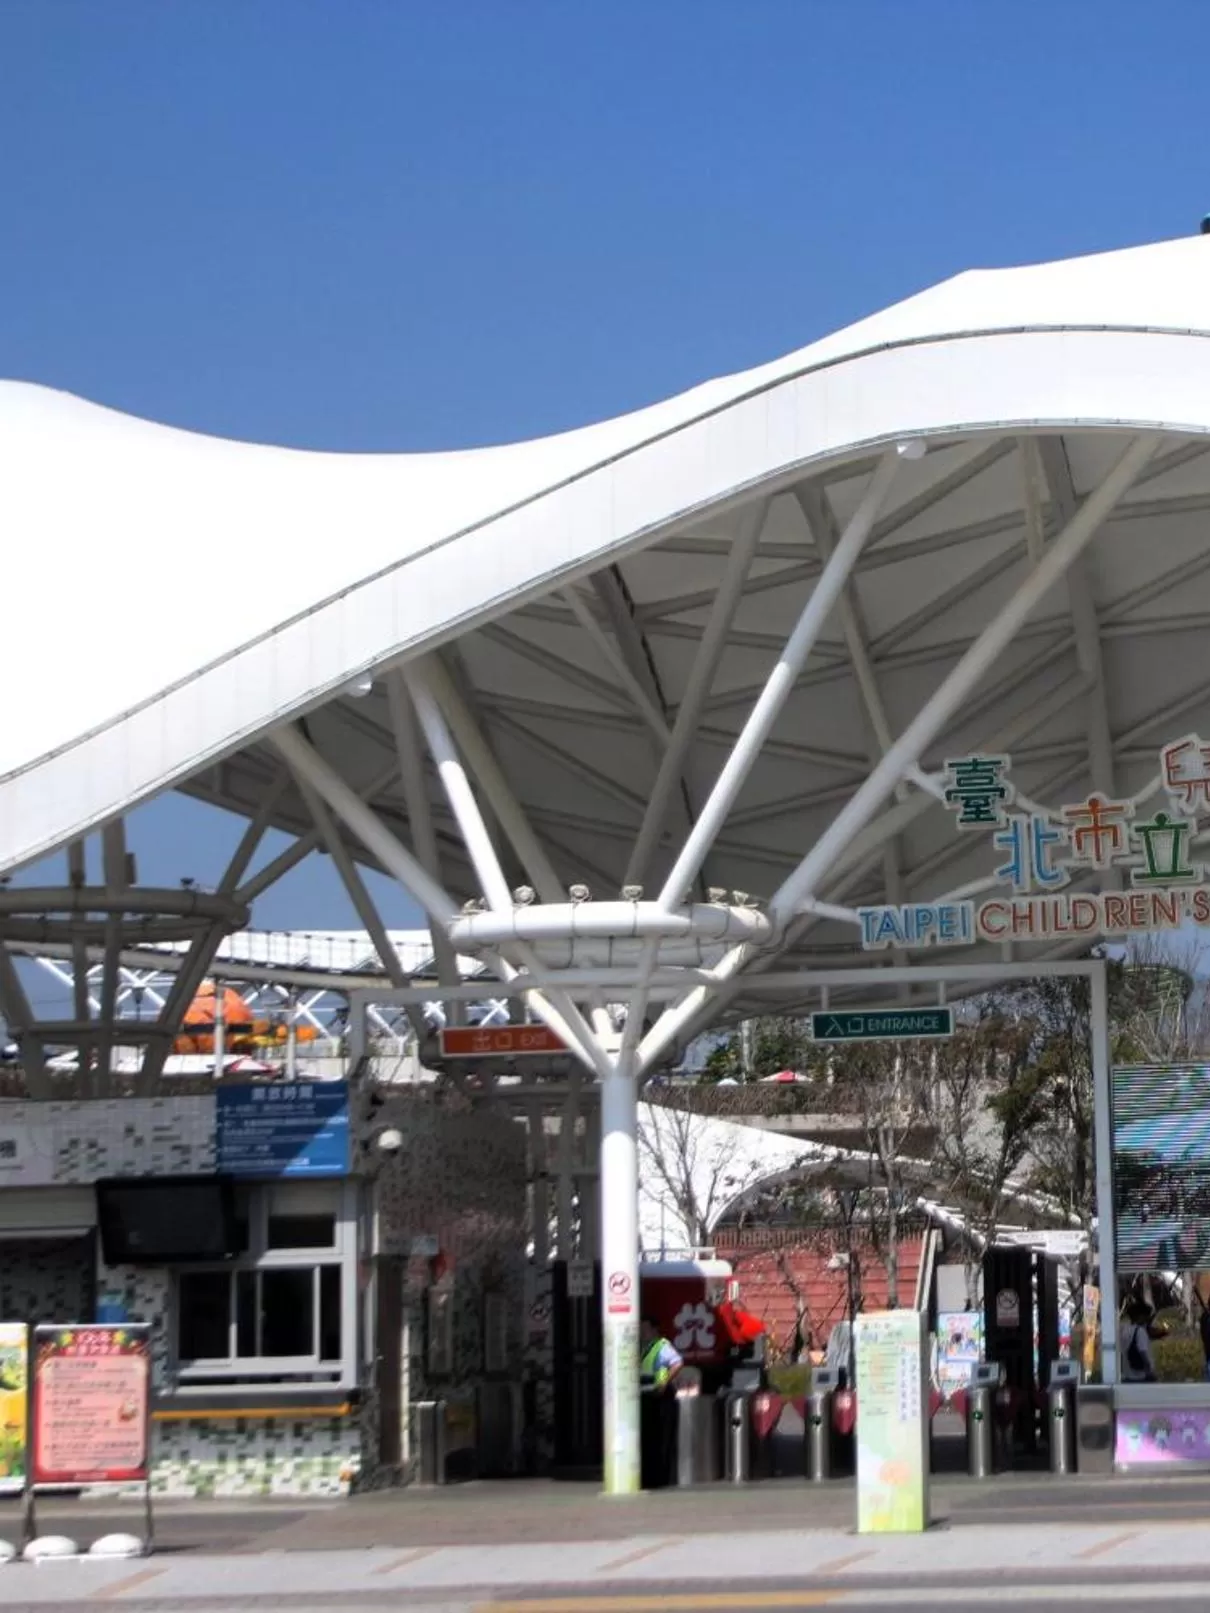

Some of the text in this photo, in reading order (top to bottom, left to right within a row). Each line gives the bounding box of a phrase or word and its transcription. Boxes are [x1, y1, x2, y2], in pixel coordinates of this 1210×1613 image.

[859, 903, 969, 943] TAIPEI
[824, 1015, 939, 1036] 入口 ENTRANCE
[471, 1030, 514, 1052] 出口
